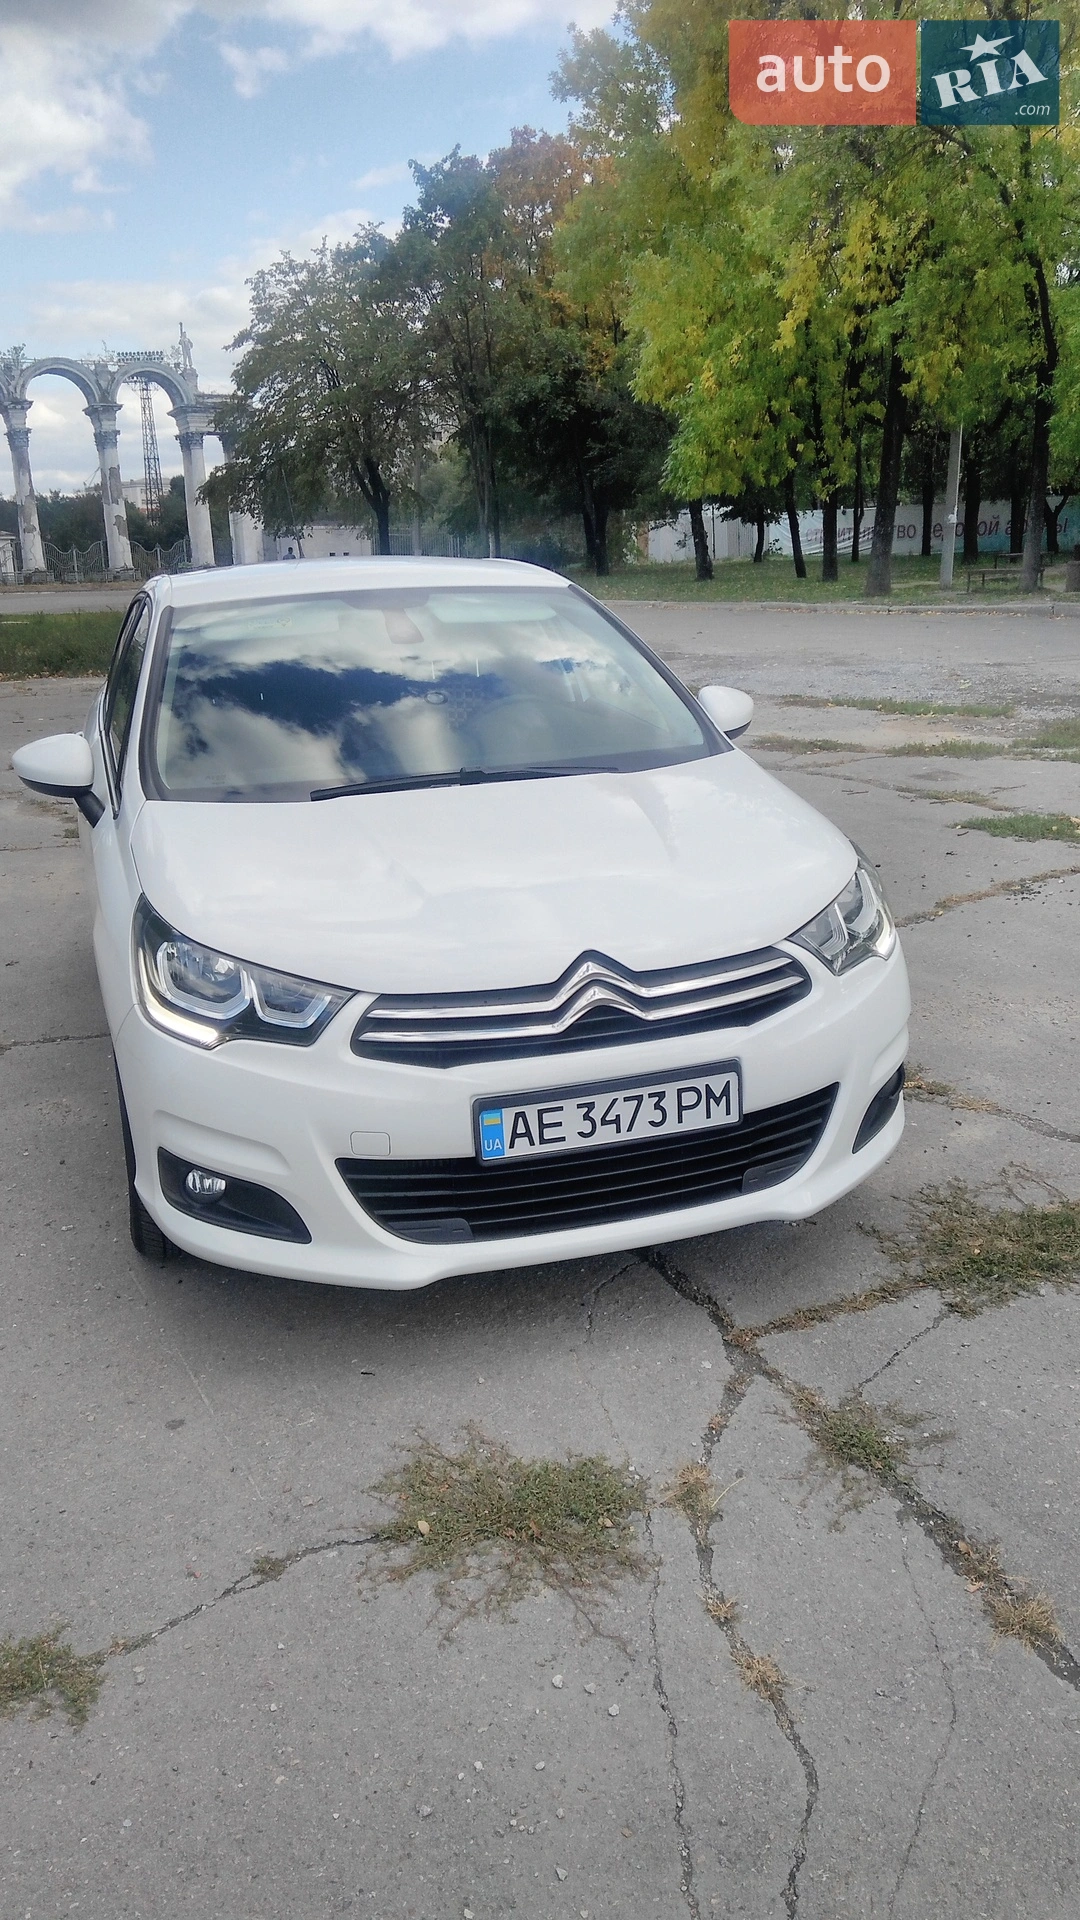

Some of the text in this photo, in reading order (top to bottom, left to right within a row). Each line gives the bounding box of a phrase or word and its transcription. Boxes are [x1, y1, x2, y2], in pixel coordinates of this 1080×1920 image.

[508, 1079, 732, 1149] AE 3473 PM
[484, 1138, 503, 1152] UA
